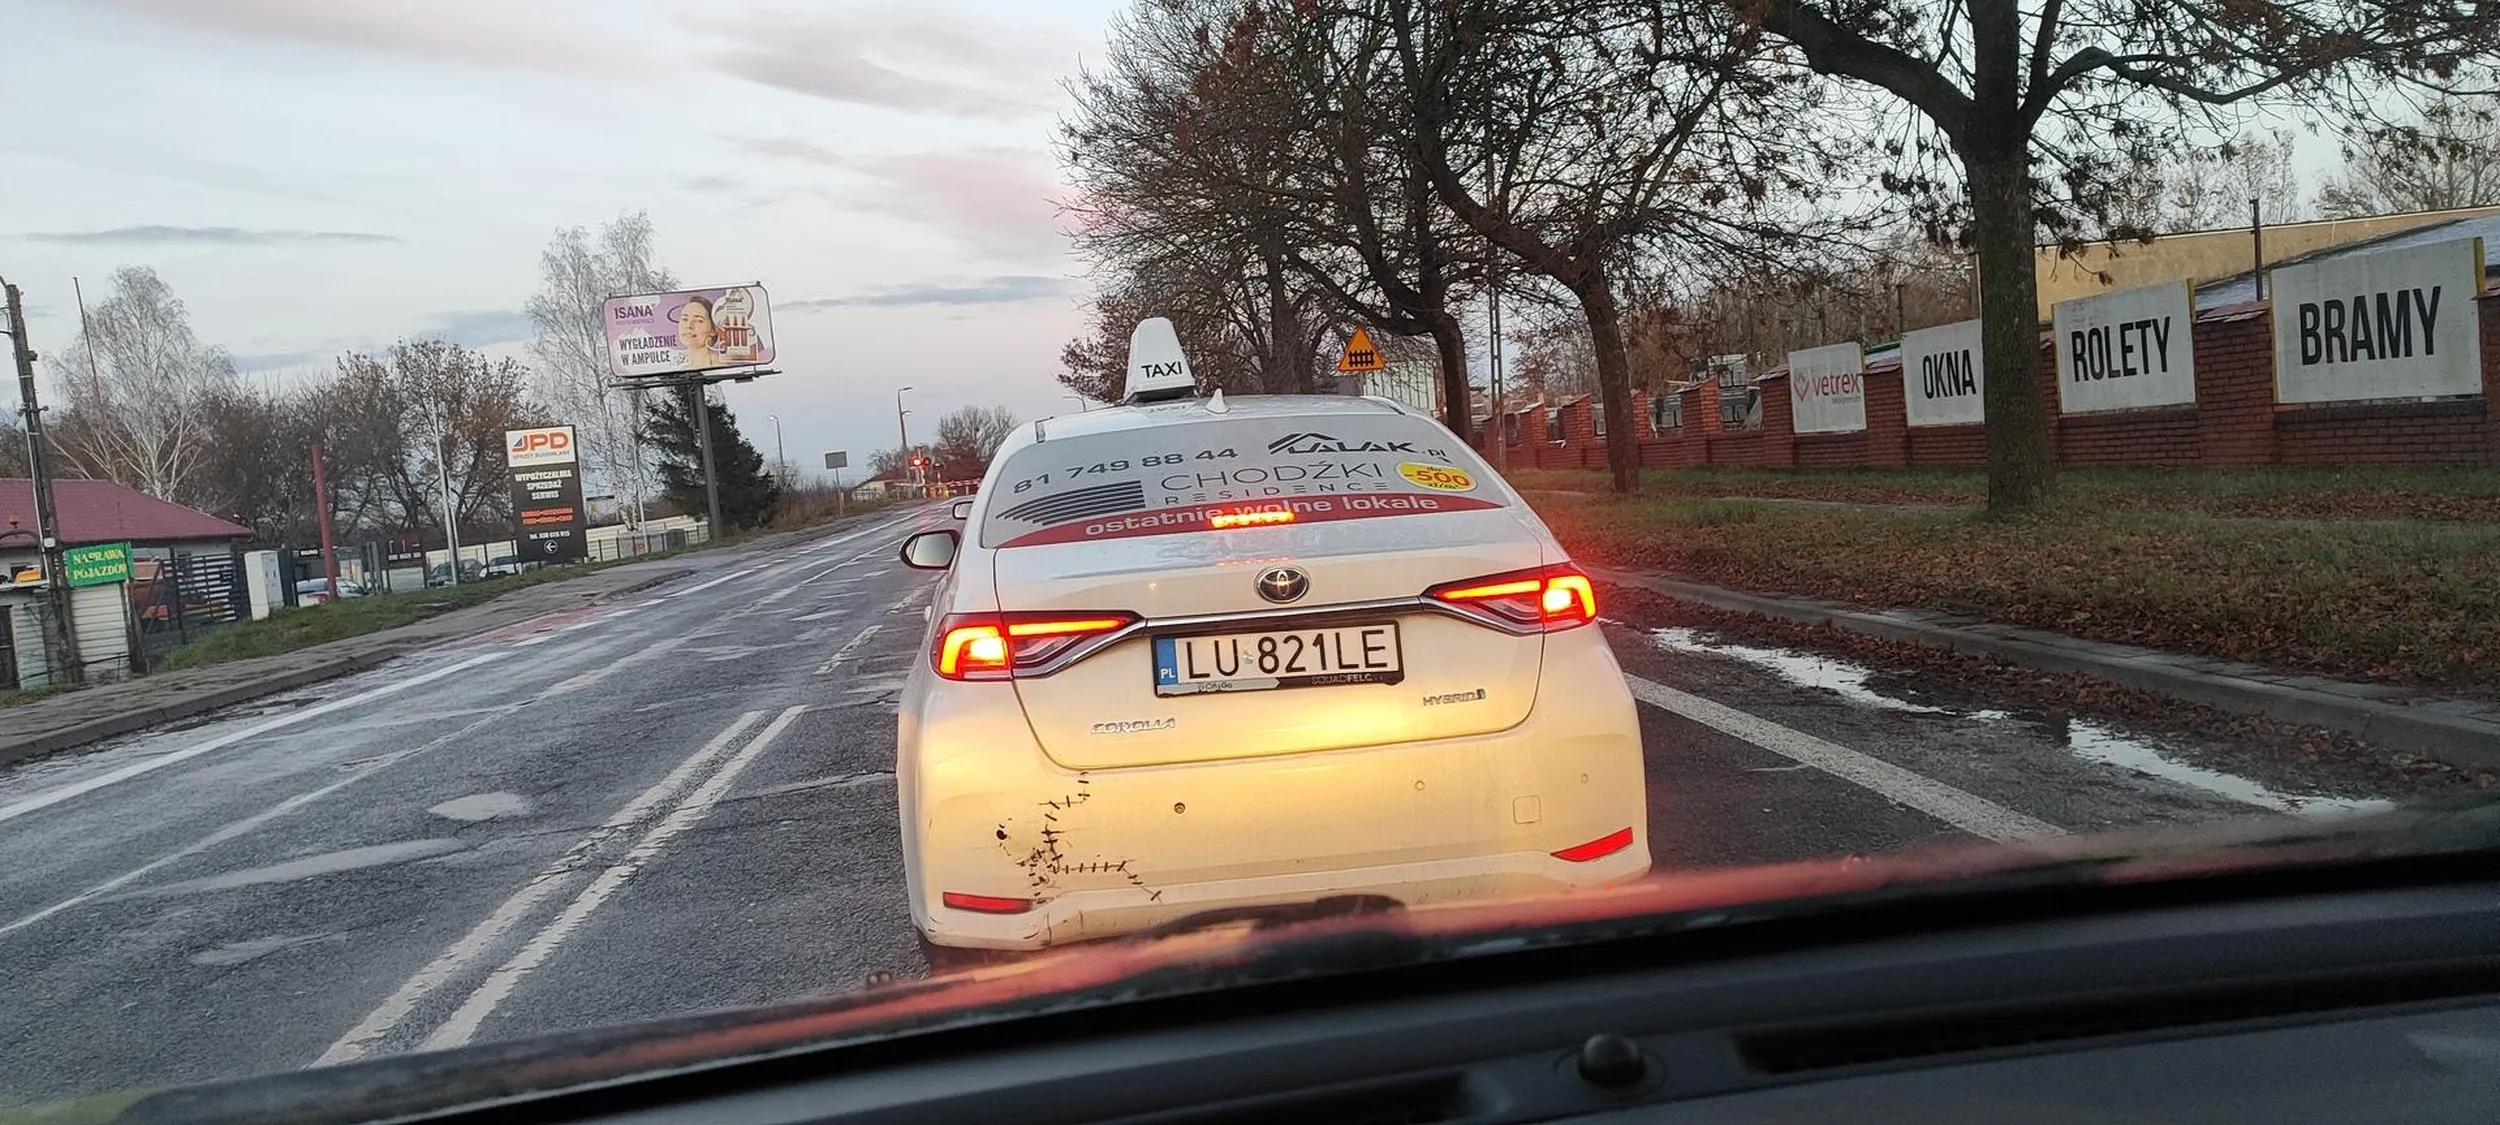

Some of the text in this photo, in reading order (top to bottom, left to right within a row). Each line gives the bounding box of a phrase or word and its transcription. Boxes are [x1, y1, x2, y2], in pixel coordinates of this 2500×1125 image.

[614, 305, 653, 319] ISANA
[2299, 286, 2441, 365] BRAMY
[621, 354, 629, 366] W
[2071, 316, 2170, 382] ROLETY
[1141, 361, 1182, 378] TAXI
[1922, 349, 1977, 399] OKNA
[1812, 373, 1861, 396] vetrex
[512, 432, 569, 452] JPD
[1013, 448, 1238, 494] 81 749 88 44
[1161, 460, 1383, 490] CHODŹKI
[1404, 470, 1470, 487] -500
[1165, 482, 1388, 505] RESIDENCE
[1085, 507, 1220, 536] ostatnie
[1343, 495, 1439, 511] lokale
[73, 549, 125, 564] NAPRAWA
[1160, 629, 1388, 679] PL LU 821LE
[1422, 690, 1476, 706] HYBRID
[1092, 717, 1175, 734] COROLLA
